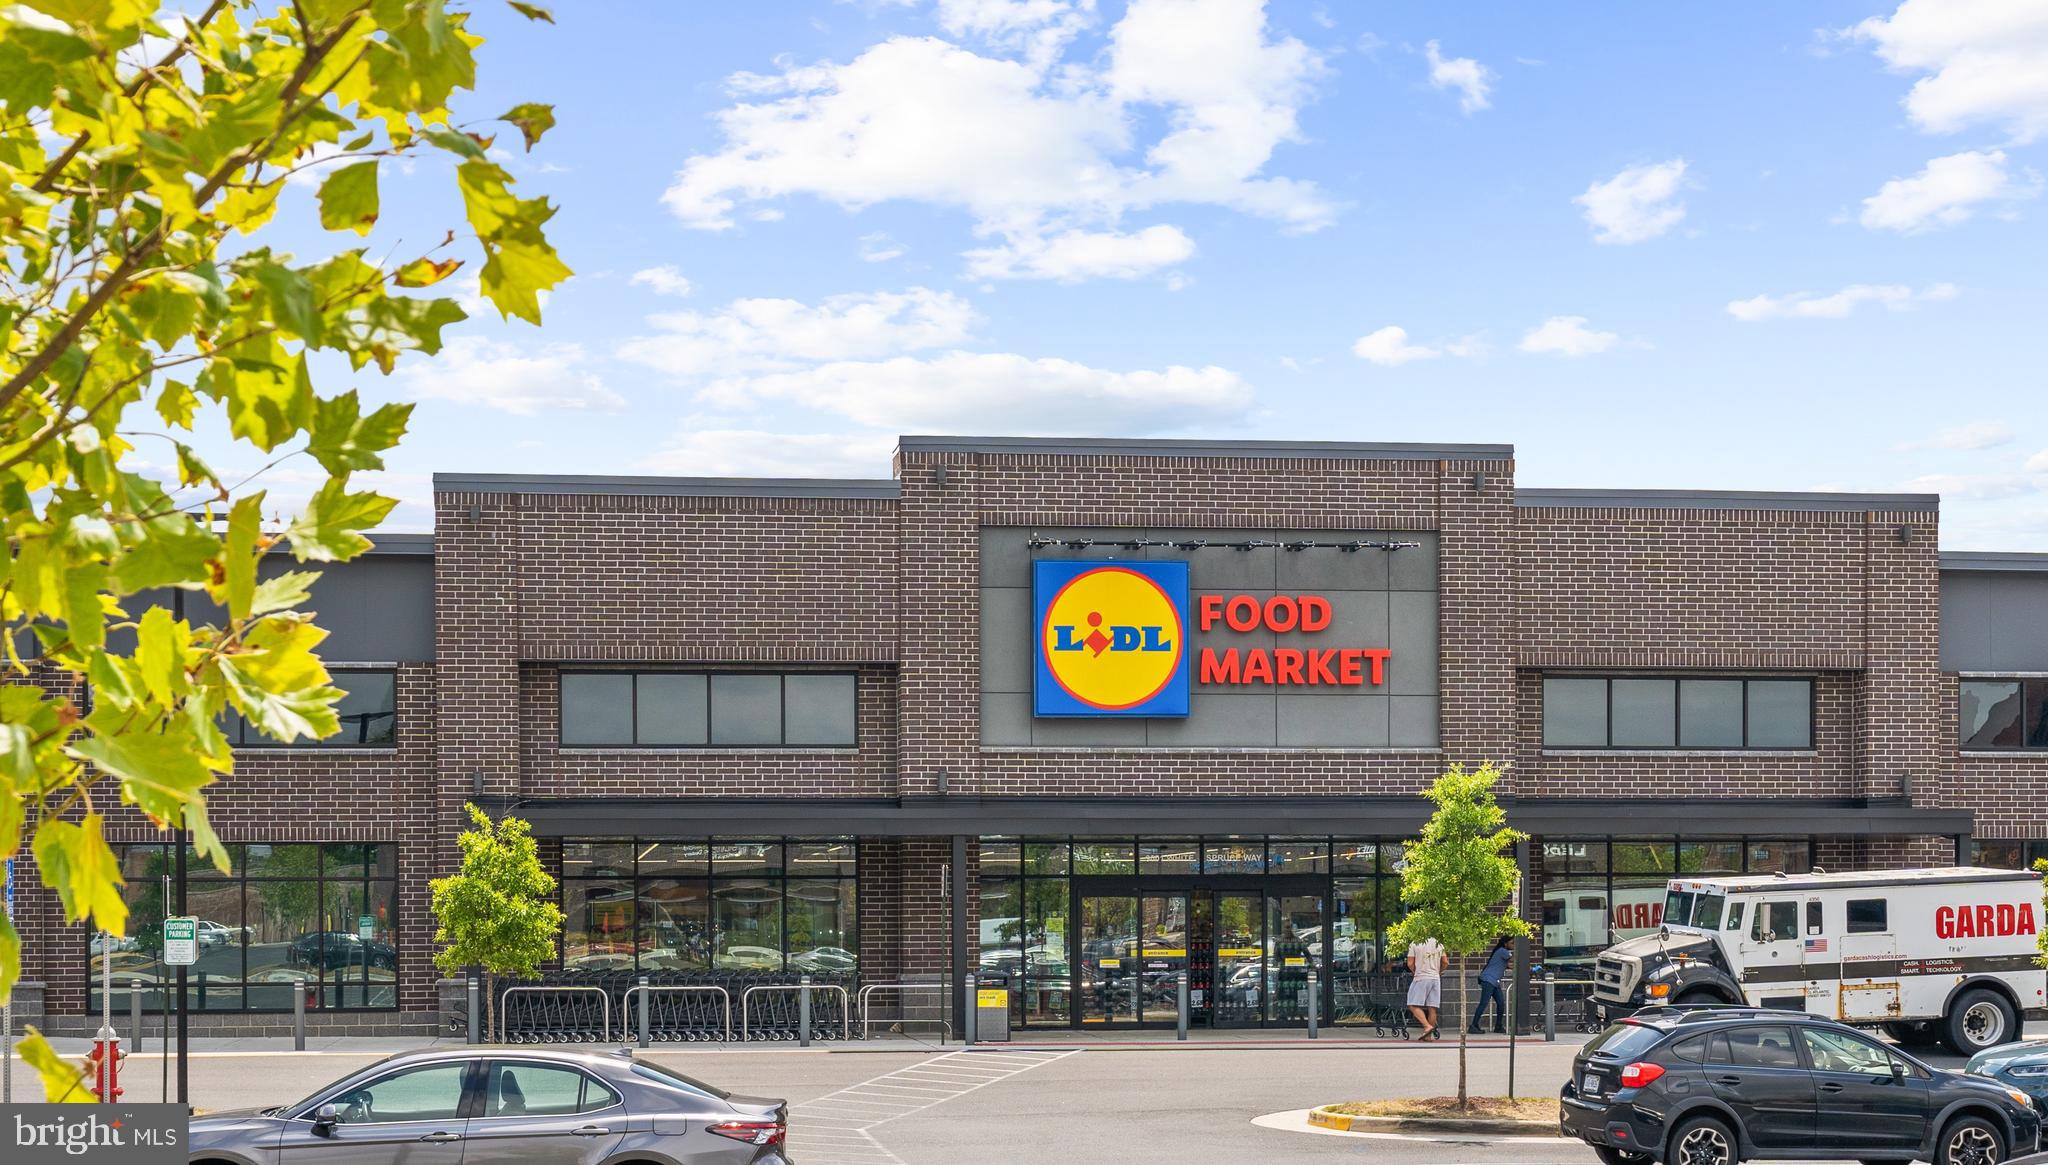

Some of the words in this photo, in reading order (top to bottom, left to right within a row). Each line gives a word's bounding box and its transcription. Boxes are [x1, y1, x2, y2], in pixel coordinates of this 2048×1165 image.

[1200, 595, 1332, 633] FOOD
[1200, 648, 1391, 686] MARKET
[1243, 854, 1262, 862] WAY
[166, 922, 193, 930] CUSTOMER
[1935, 903, 2036, 940] GARDA
[1843, 953, 1908, 962] gardacashlogistics.com
